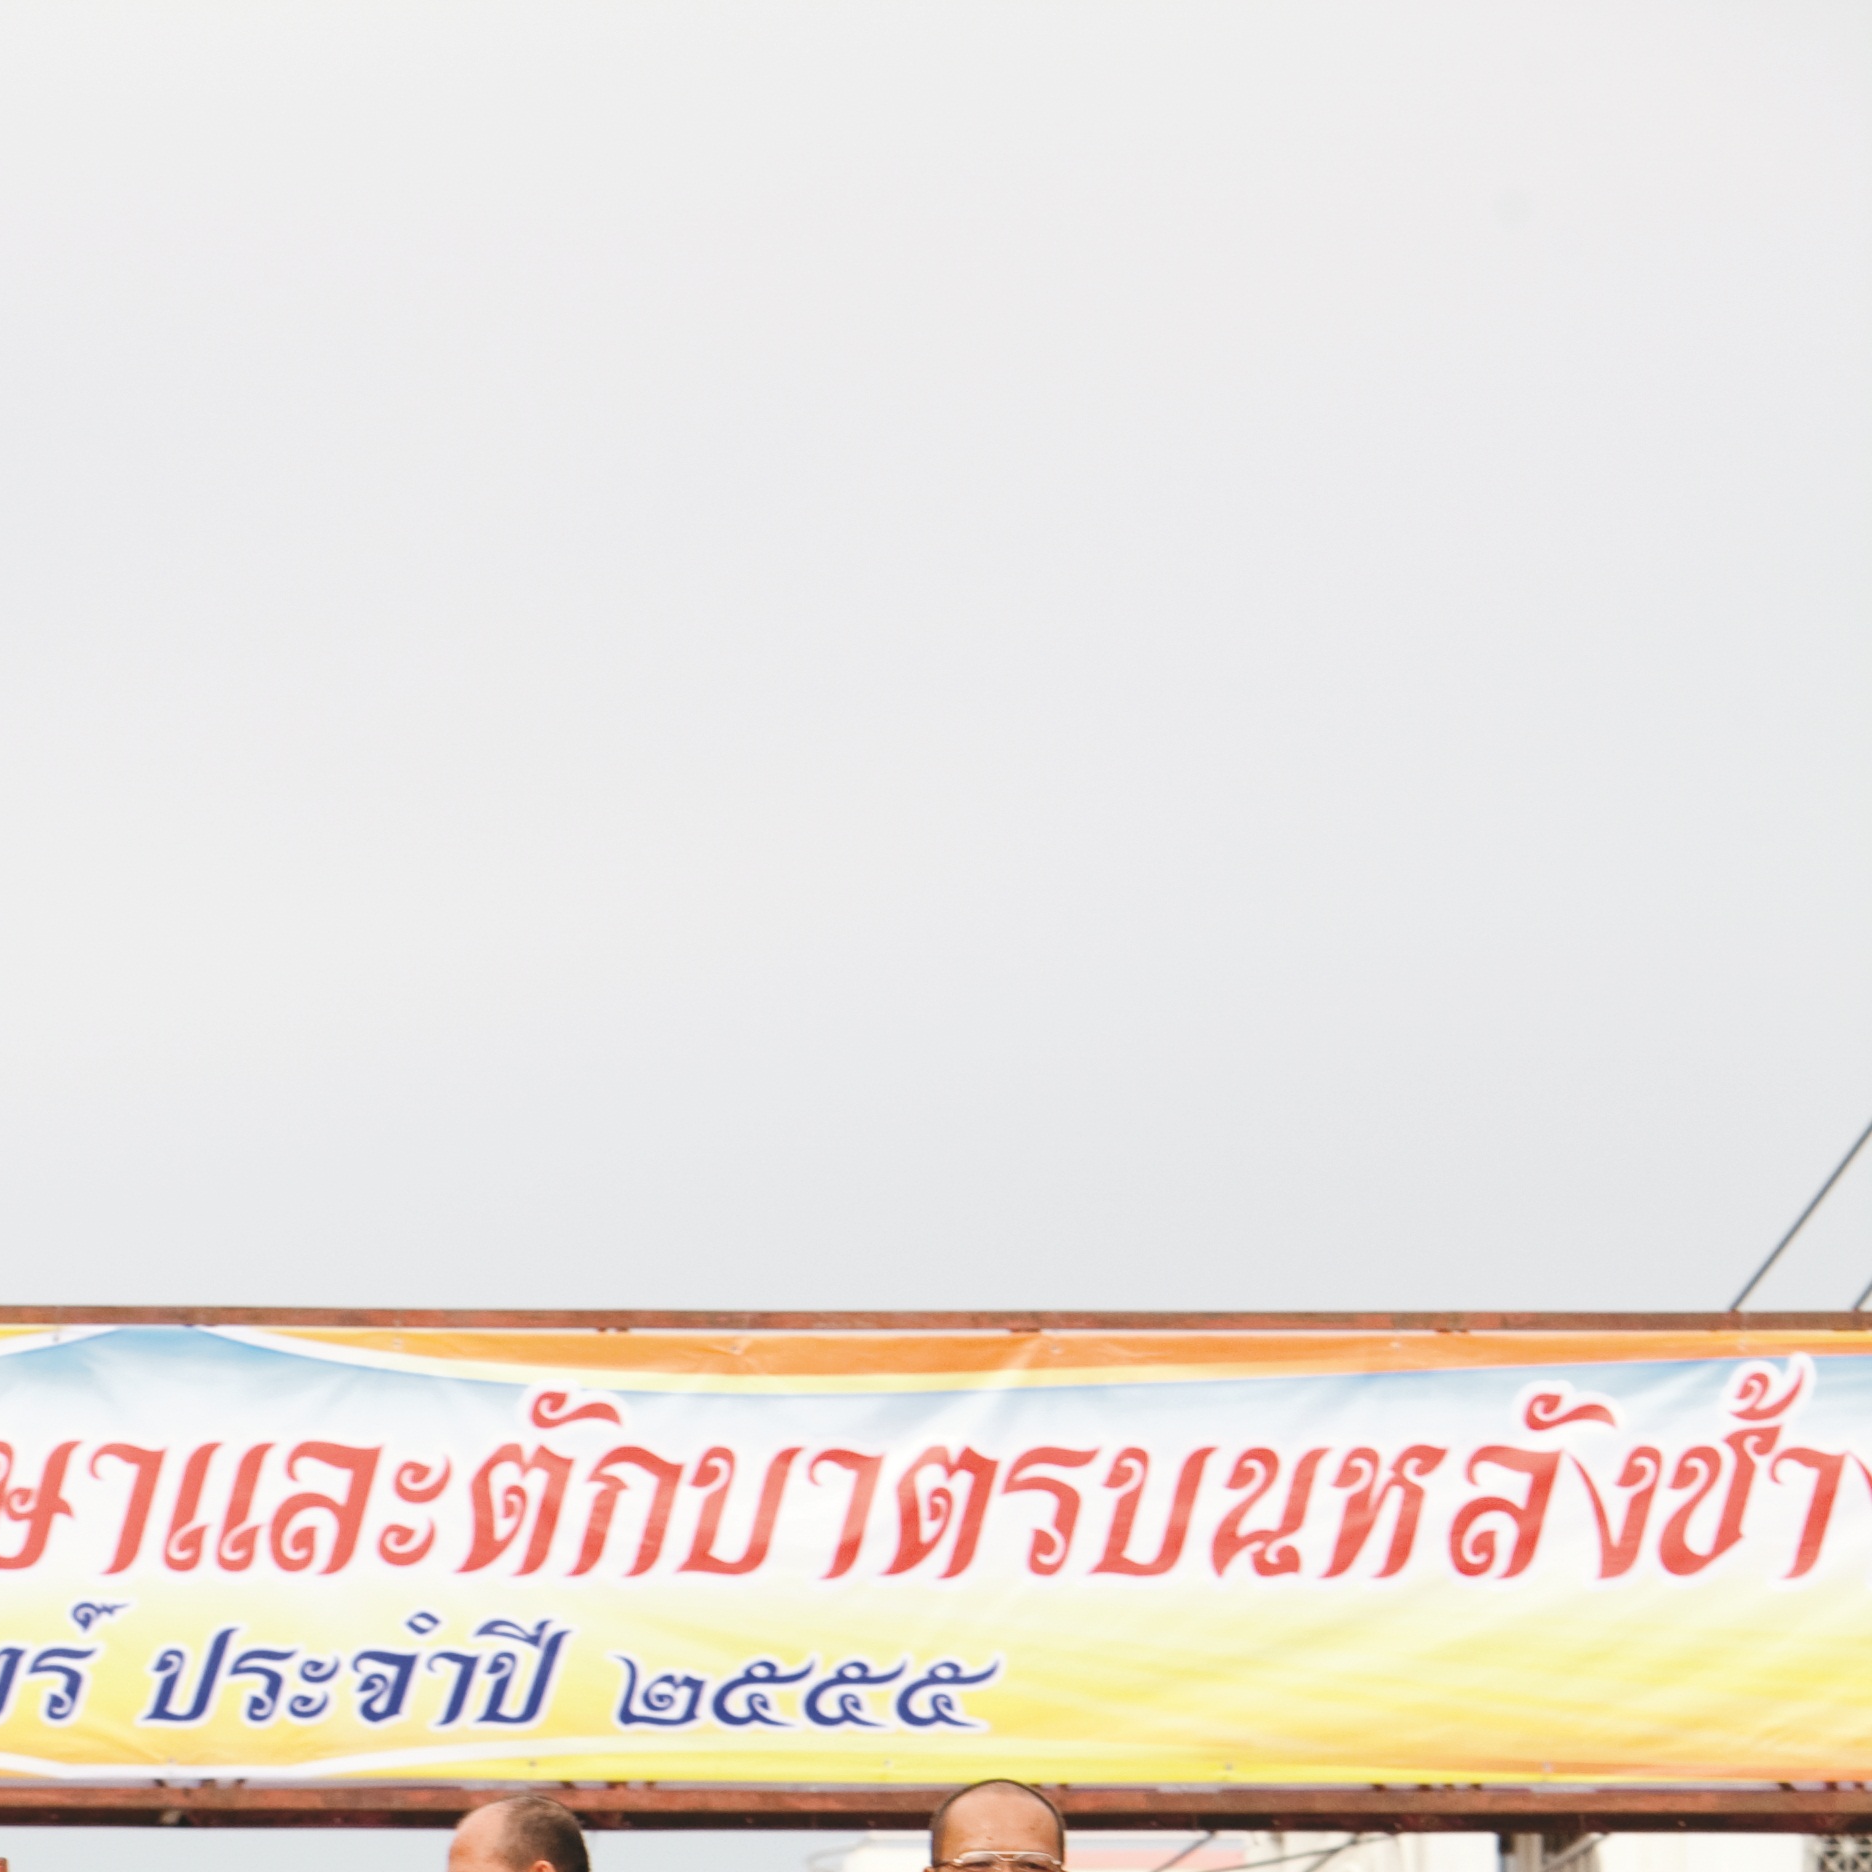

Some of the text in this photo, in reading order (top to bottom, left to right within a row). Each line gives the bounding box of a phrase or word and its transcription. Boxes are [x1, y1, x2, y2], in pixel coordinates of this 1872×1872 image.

[146, 1611, 569, 1726] ประจำปี
[615, 1656, 998, 1728] ๒๕๕๕
